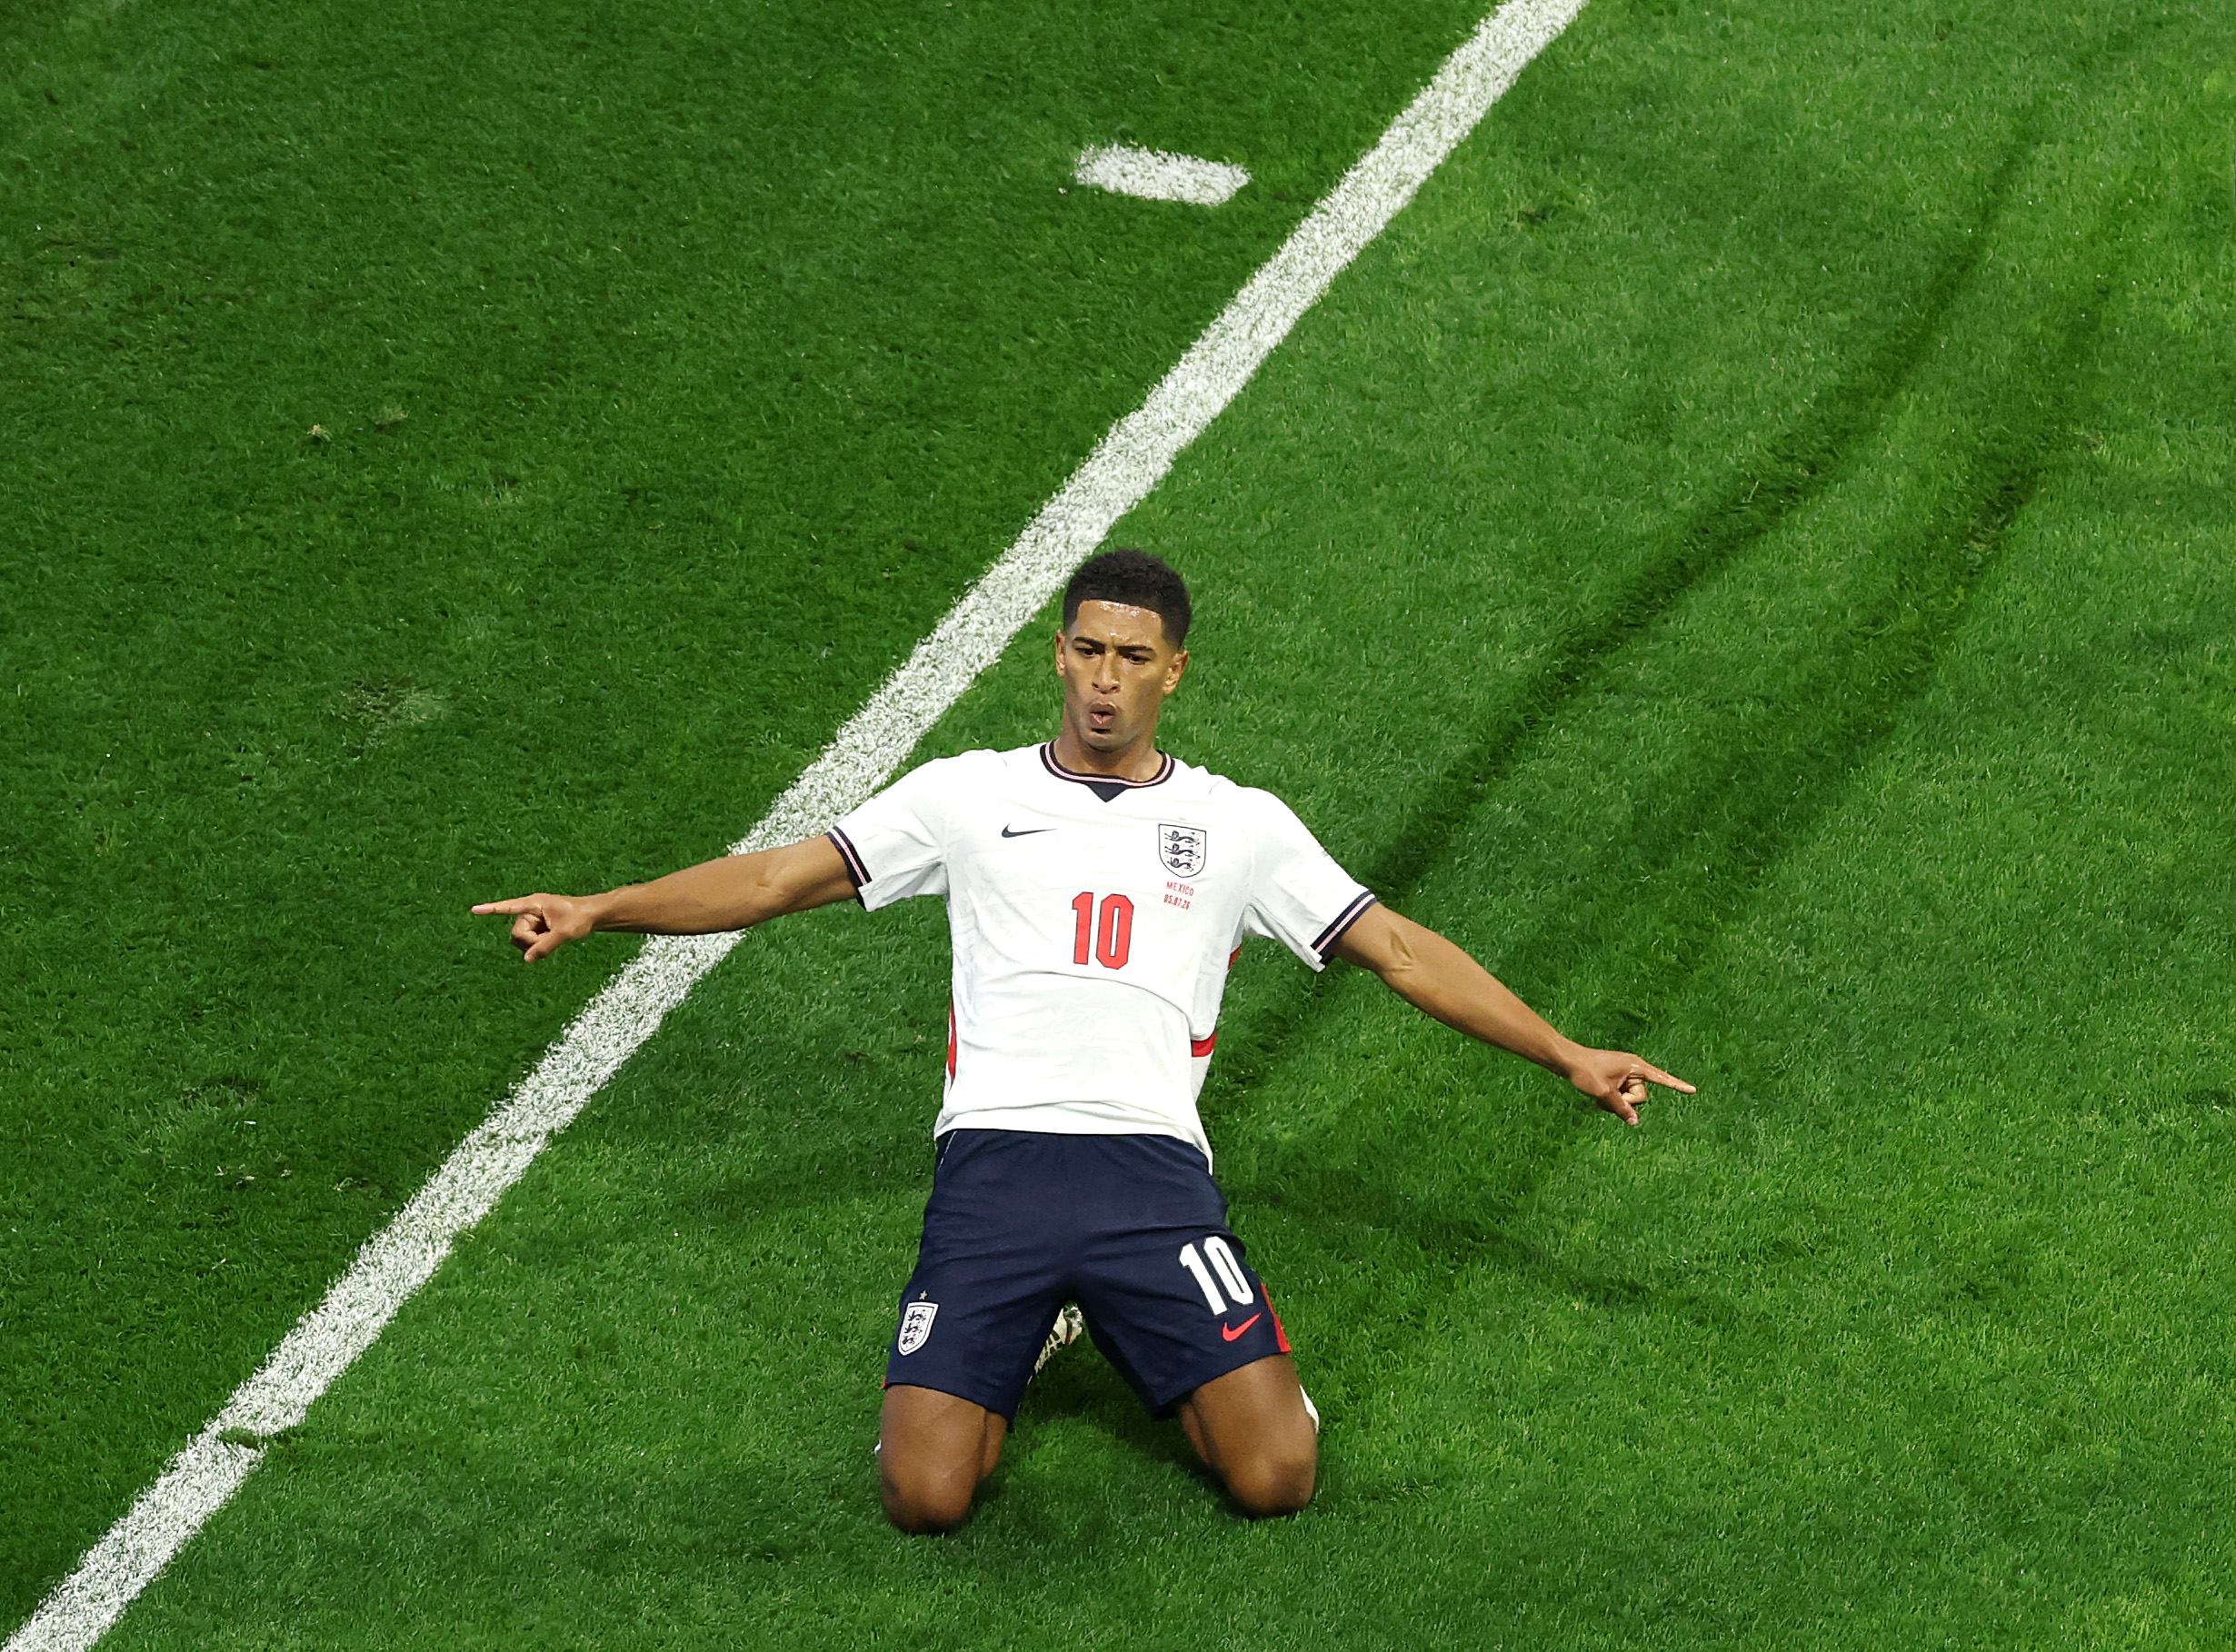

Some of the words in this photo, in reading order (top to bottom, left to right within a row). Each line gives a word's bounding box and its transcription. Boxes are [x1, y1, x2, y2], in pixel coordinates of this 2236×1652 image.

[1166, 881, 1194, 896] MEXICO
[1072, 891, 1134, 970] 10
[1179, 1235, 1254, 1317] 10
